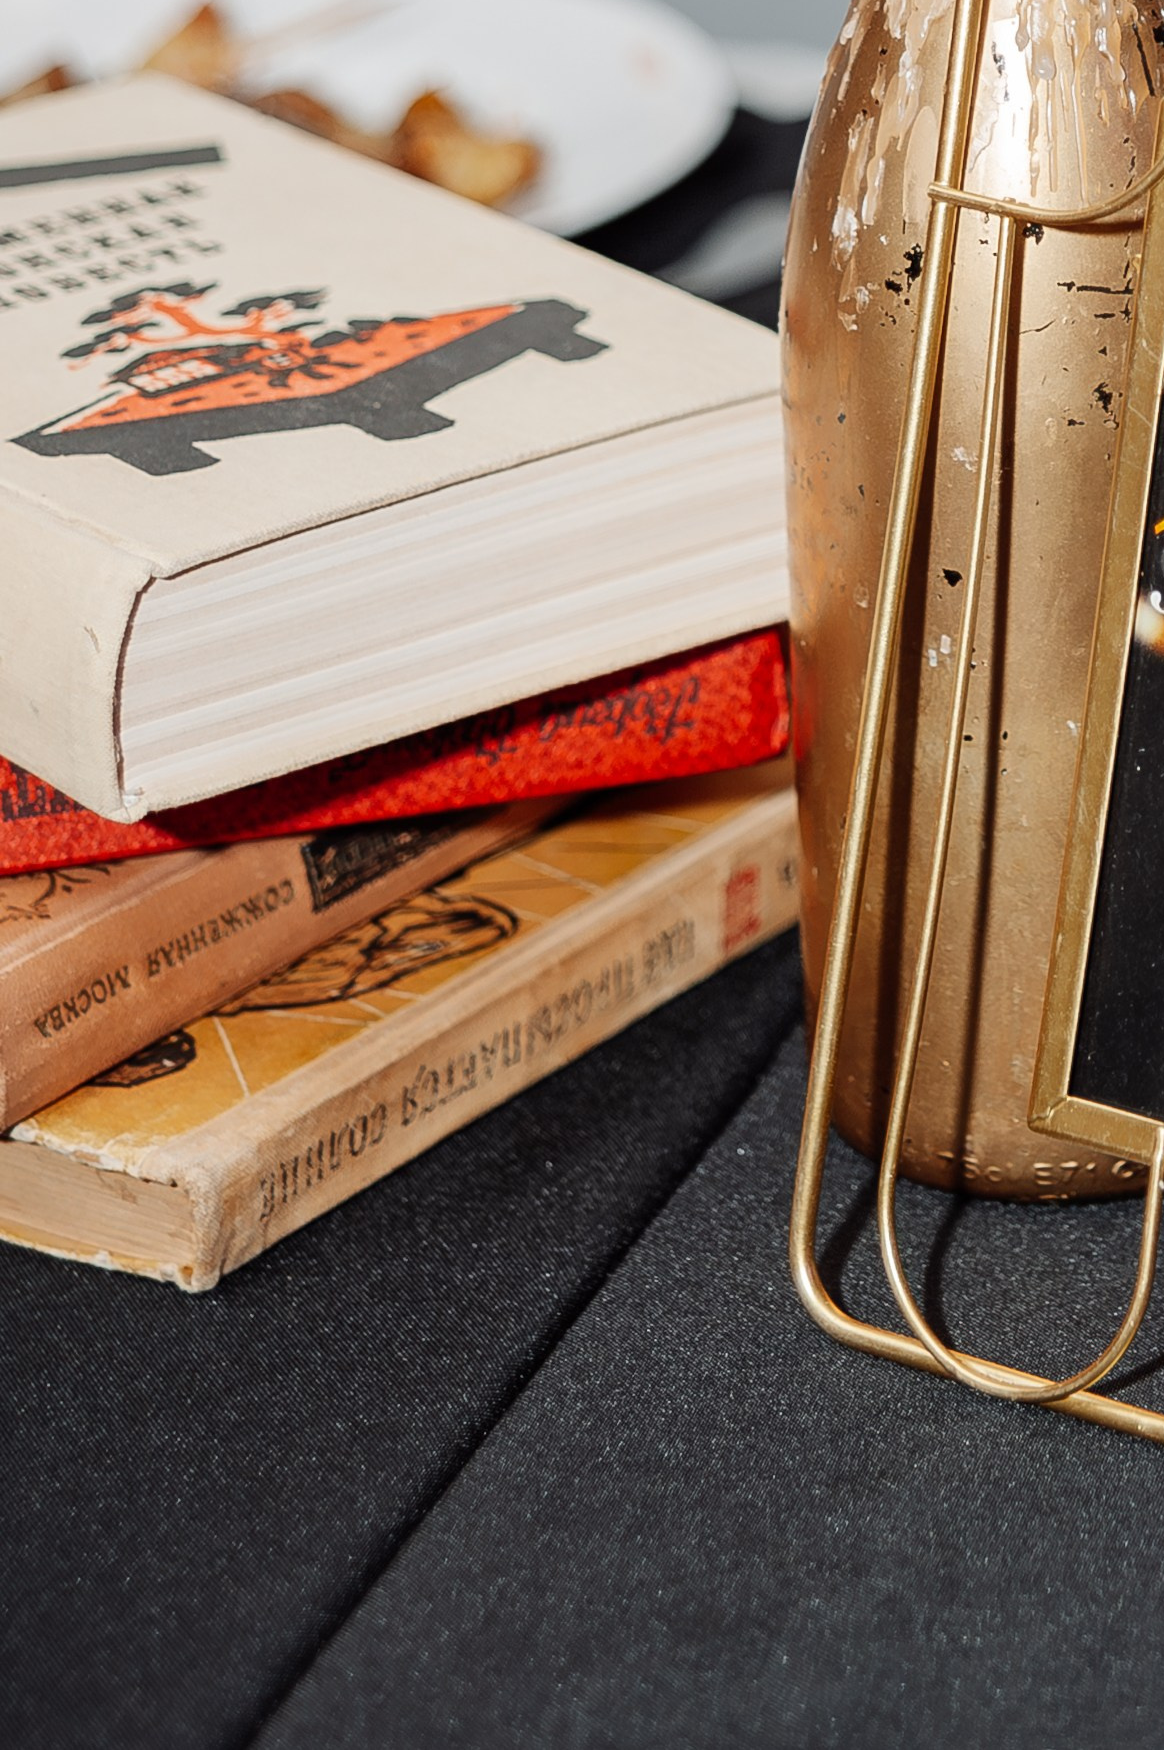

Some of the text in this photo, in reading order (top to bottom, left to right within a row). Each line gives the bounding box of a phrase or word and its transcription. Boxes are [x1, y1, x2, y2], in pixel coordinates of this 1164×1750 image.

[32, 876, 296, 1040] СОЖЖЕННАЯ МОСКВА
[258, 1102, 388, 1221] СОЛНЦЕ
